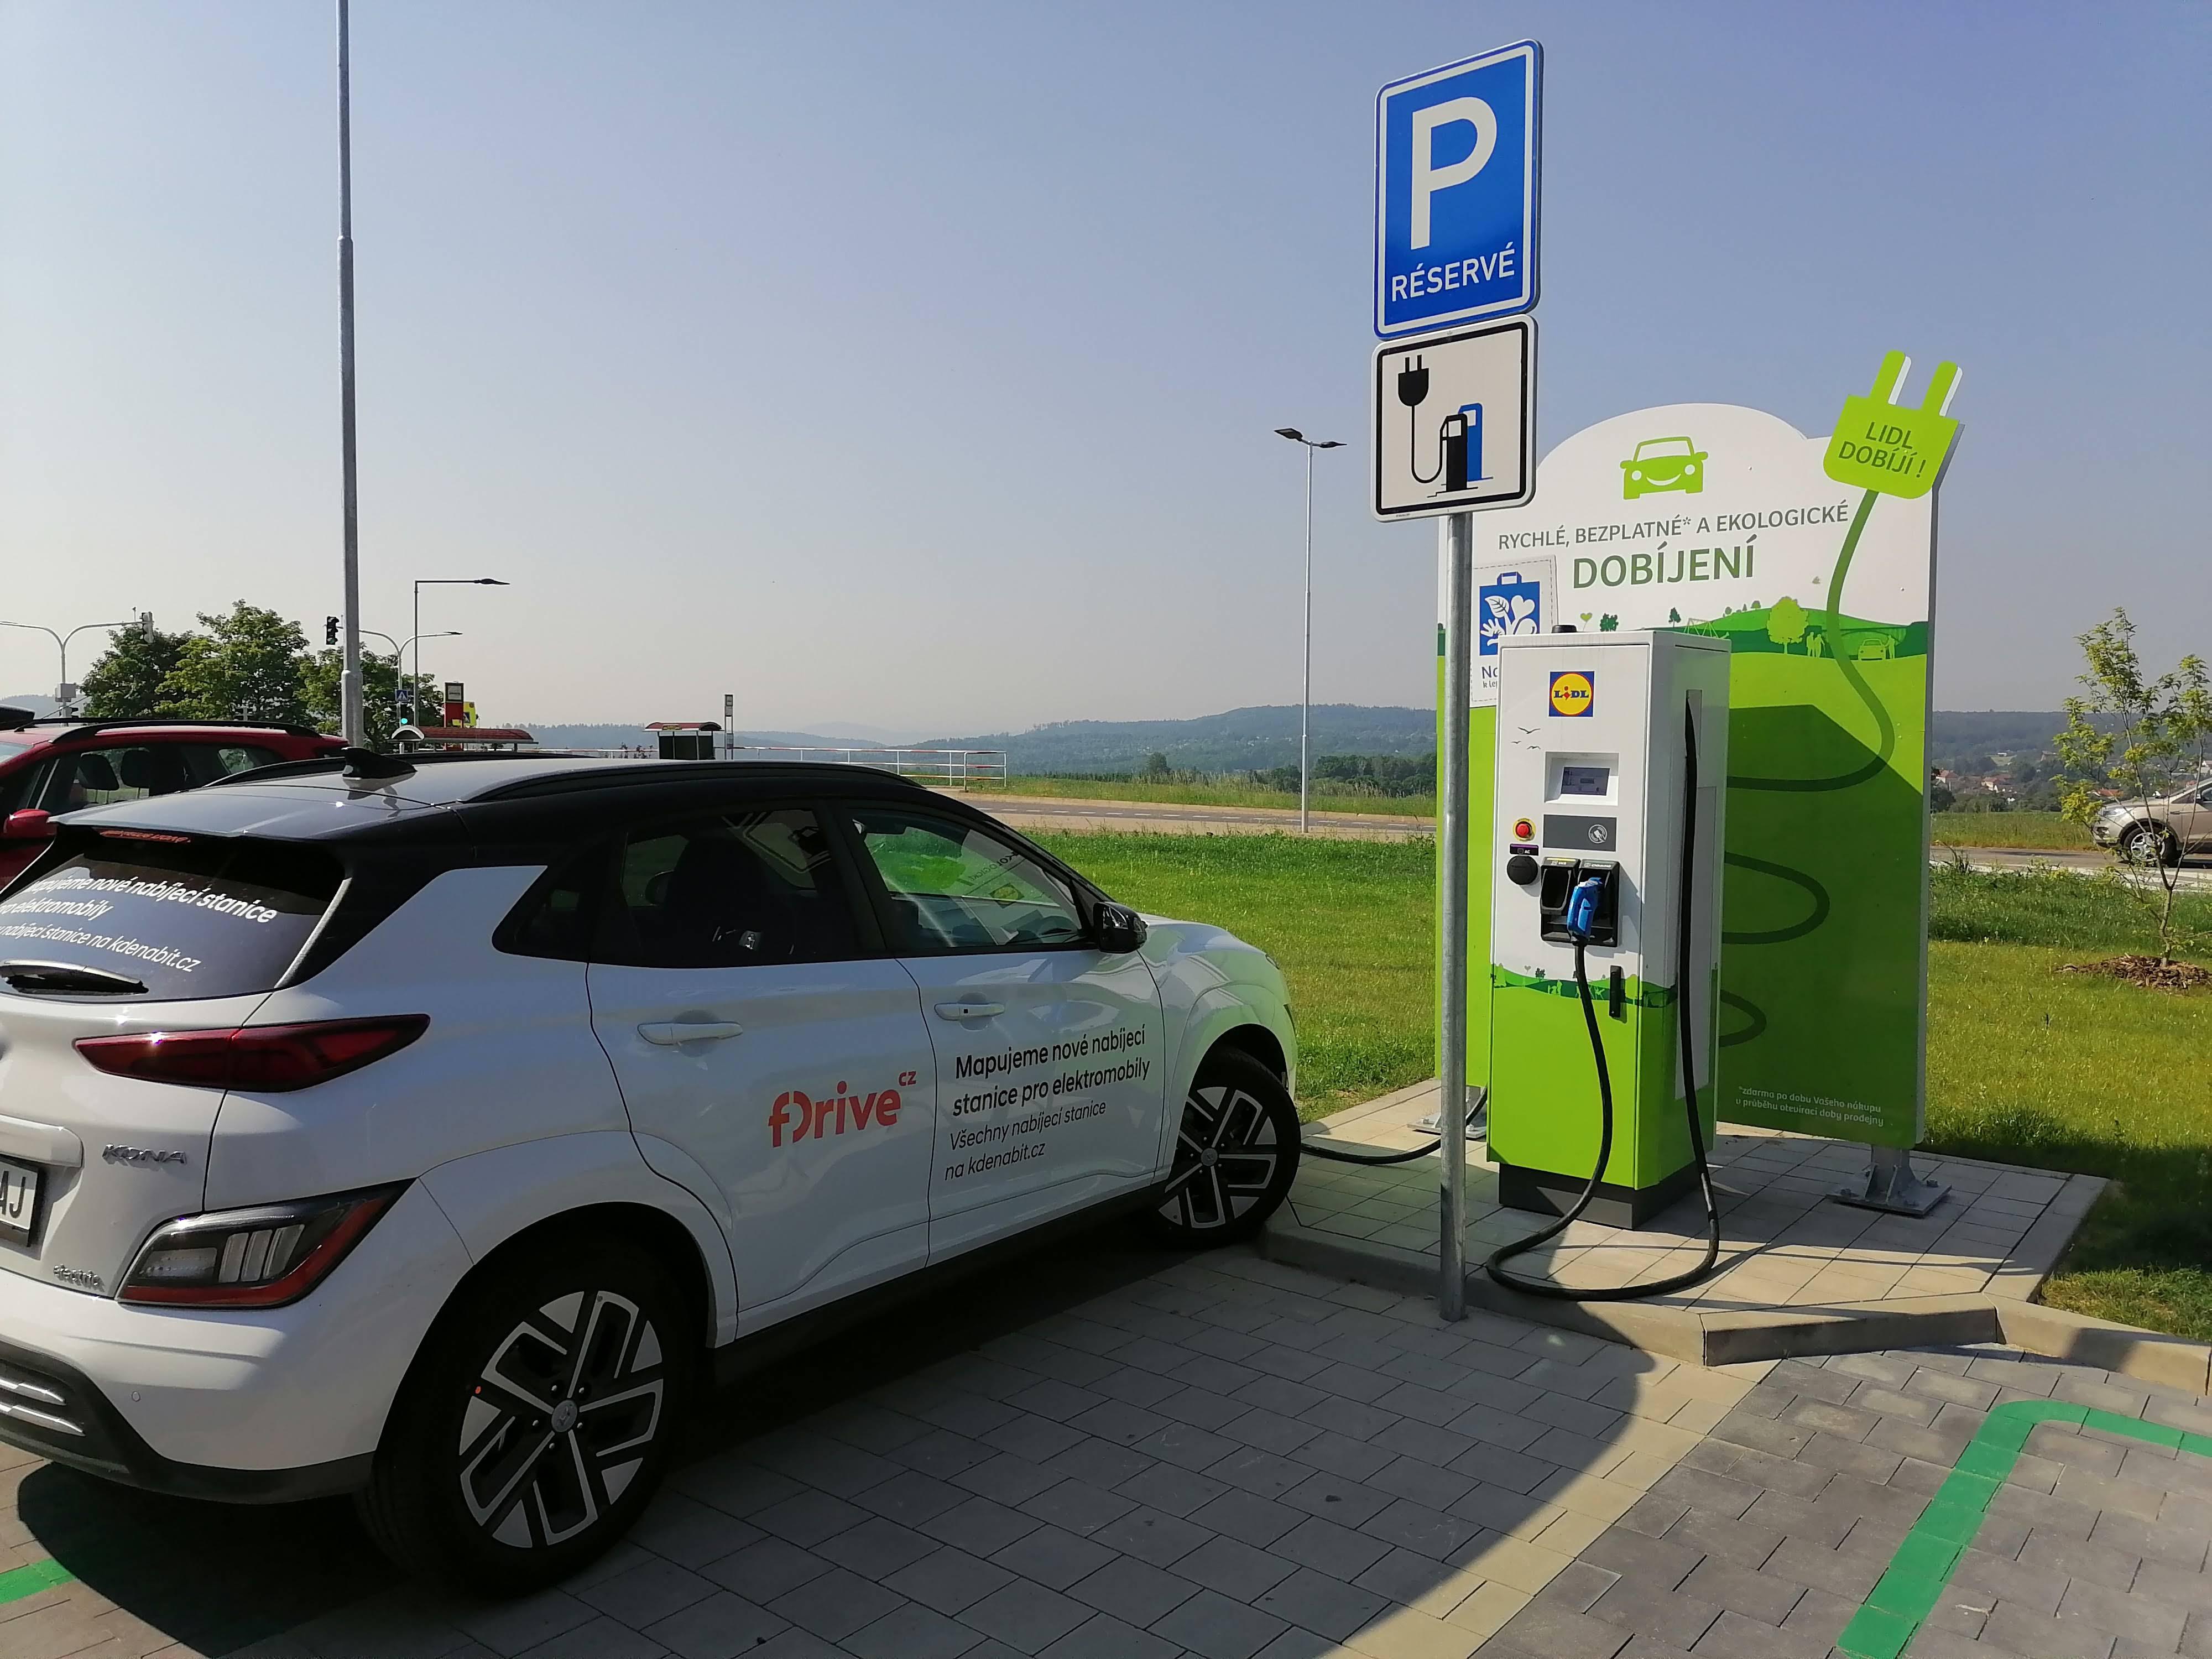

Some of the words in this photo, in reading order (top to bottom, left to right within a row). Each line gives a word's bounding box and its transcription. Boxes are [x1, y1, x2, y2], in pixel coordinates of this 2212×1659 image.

[1411, 96, 1498, 250] P
[1391, 242, 1515, 302] RÉSERVÉ
[1866, 421, 1913, 450] LIDL
[1838, 441, 1918, 475] DOBÍJÍ
[1498, 524, 1571, 550] RYCHLÉ,
[1696, 517, 1710, 534] A
[1717, 499, 1849, 532] EKOLOGICKÉ
[1573, 534, 1758, 589] DOBÍJENÍ
[11, 897, 114, 921] elektromobily
[197, 892, 278, 923] stanice
[86, 935, 111, 948] na
[107, 935, 202, 973] kdenabit.cz
[955, 1047, 1048, 1079] Mapujeme
[1052, 1034, 1089, 1062] nové
[1092, 1024, 1146, 1055] nabíjecí
[952, 1086, 1018, 1117] stanice
[1021, 1082, 1050, 1107] pro
[1052, 1057, 1151, 1095] elektromobily
[1776, 1092, 1787, 1101] po
[1790, 1093, 1812, 1104] dobu
[1813, 1095, 1845, 1108] Vašeho
[950, 1123, 1010, 1151] Všechny
[1011, 1107, 1063, 1137] nabíjecí
[1064, 1100, 1107, 1124] stanice
[1819, 1108, 1842, 1121] doby
[1844, 1113, 1885, 1128] prodejny
[102, 1144, 187, 1165] KONA
[944, 1164, 964, 1181] na
[968, 1142, 1046, 1175] kdenabit.cz
